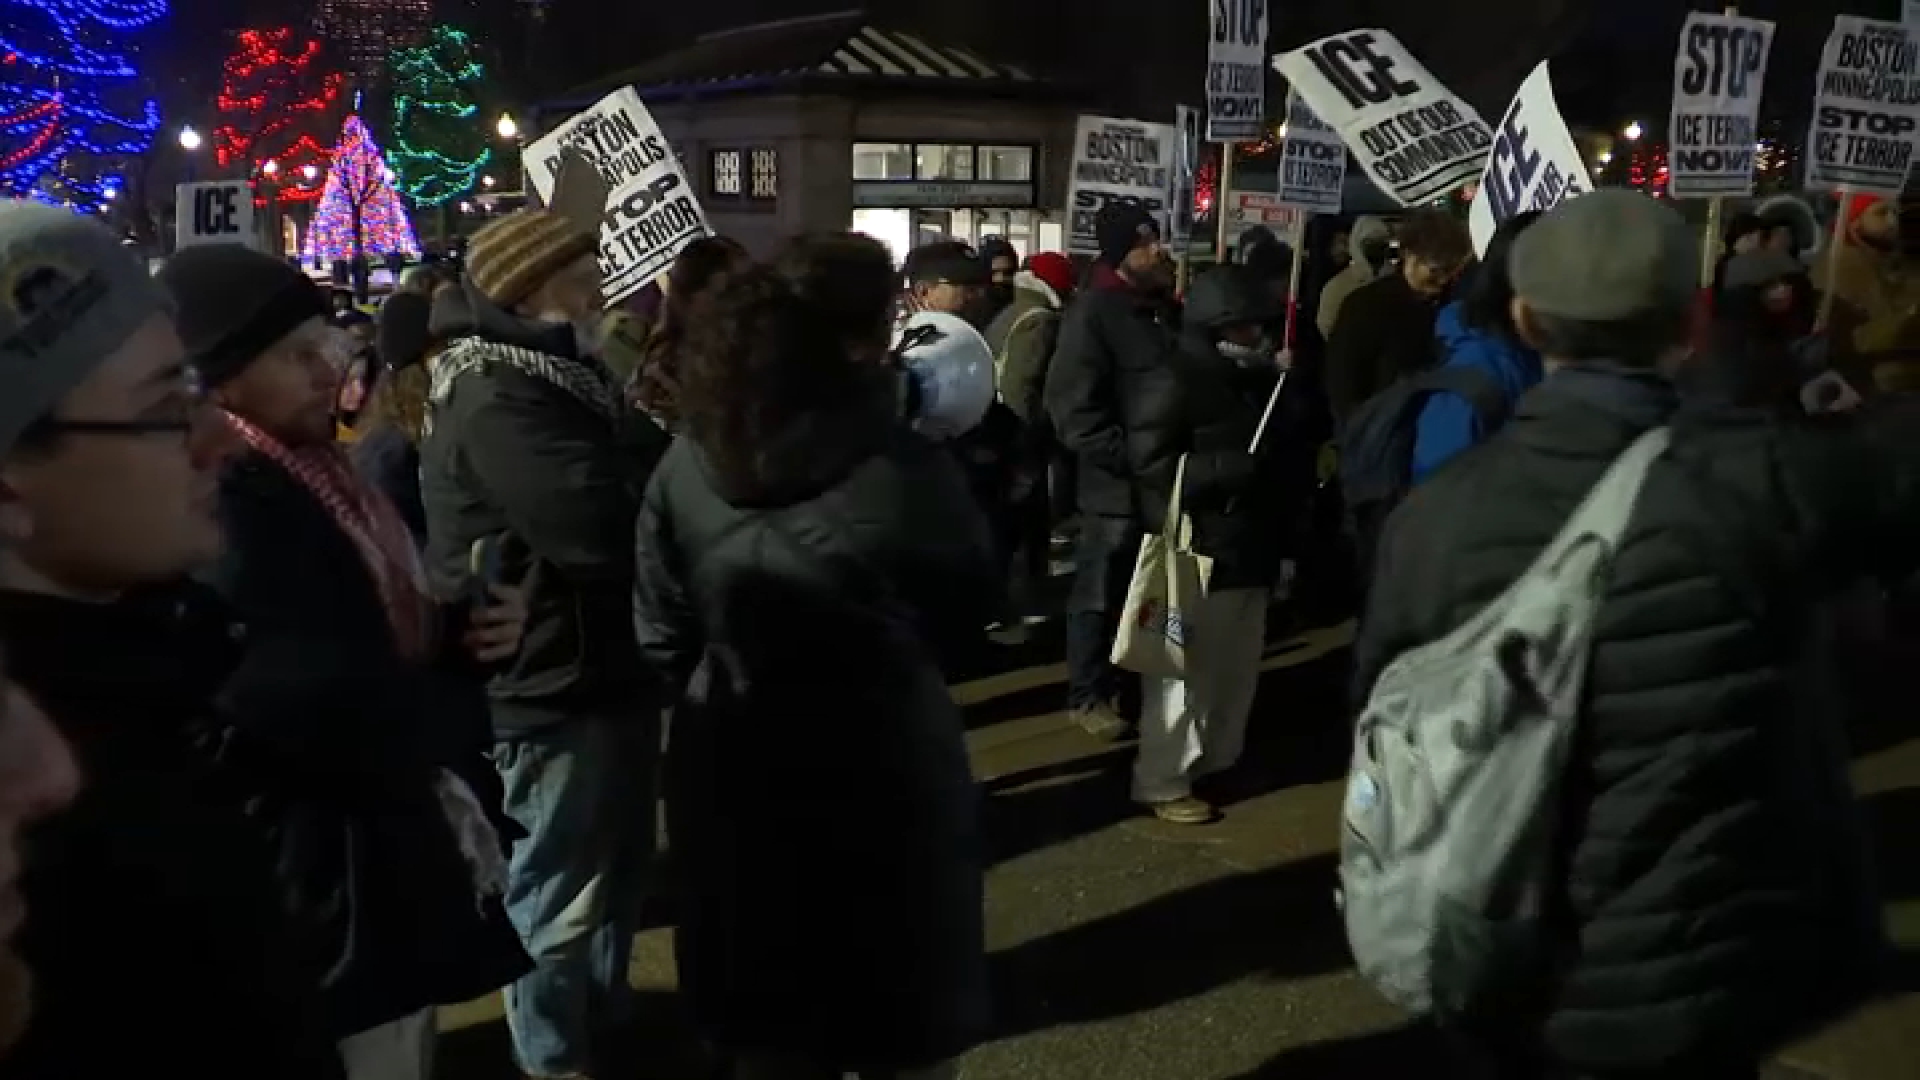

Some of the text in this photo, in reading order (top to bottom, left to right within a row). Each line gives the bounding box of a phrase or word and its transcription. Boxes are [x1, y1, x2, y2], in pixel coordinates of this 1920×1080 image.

[1304, 33, 1421, 109] ICE
[1683, 22, 1764, 98] STOP
[1838, 33, 1918, 75] BOSTON
[1360, 99, 1462, 156] OUT OF OUR
[1677, 115, 1701, 145] ICE
[1818, 105, 1916, 135] STOP
[1087, 131, 1160, 165] BOSTON
[1287, 138, 1342, 161] STOP
[1372, 120, 1492, 184] COMMUNITIES
[1485, 98, 1542, 221] ICE
[1816, 131, 1913, 169] ICE TERROR
[194, 187, 240, 236] ICE
[602, 173, 681, 232] TOP
[613, 196, 700, 261] TERROR
